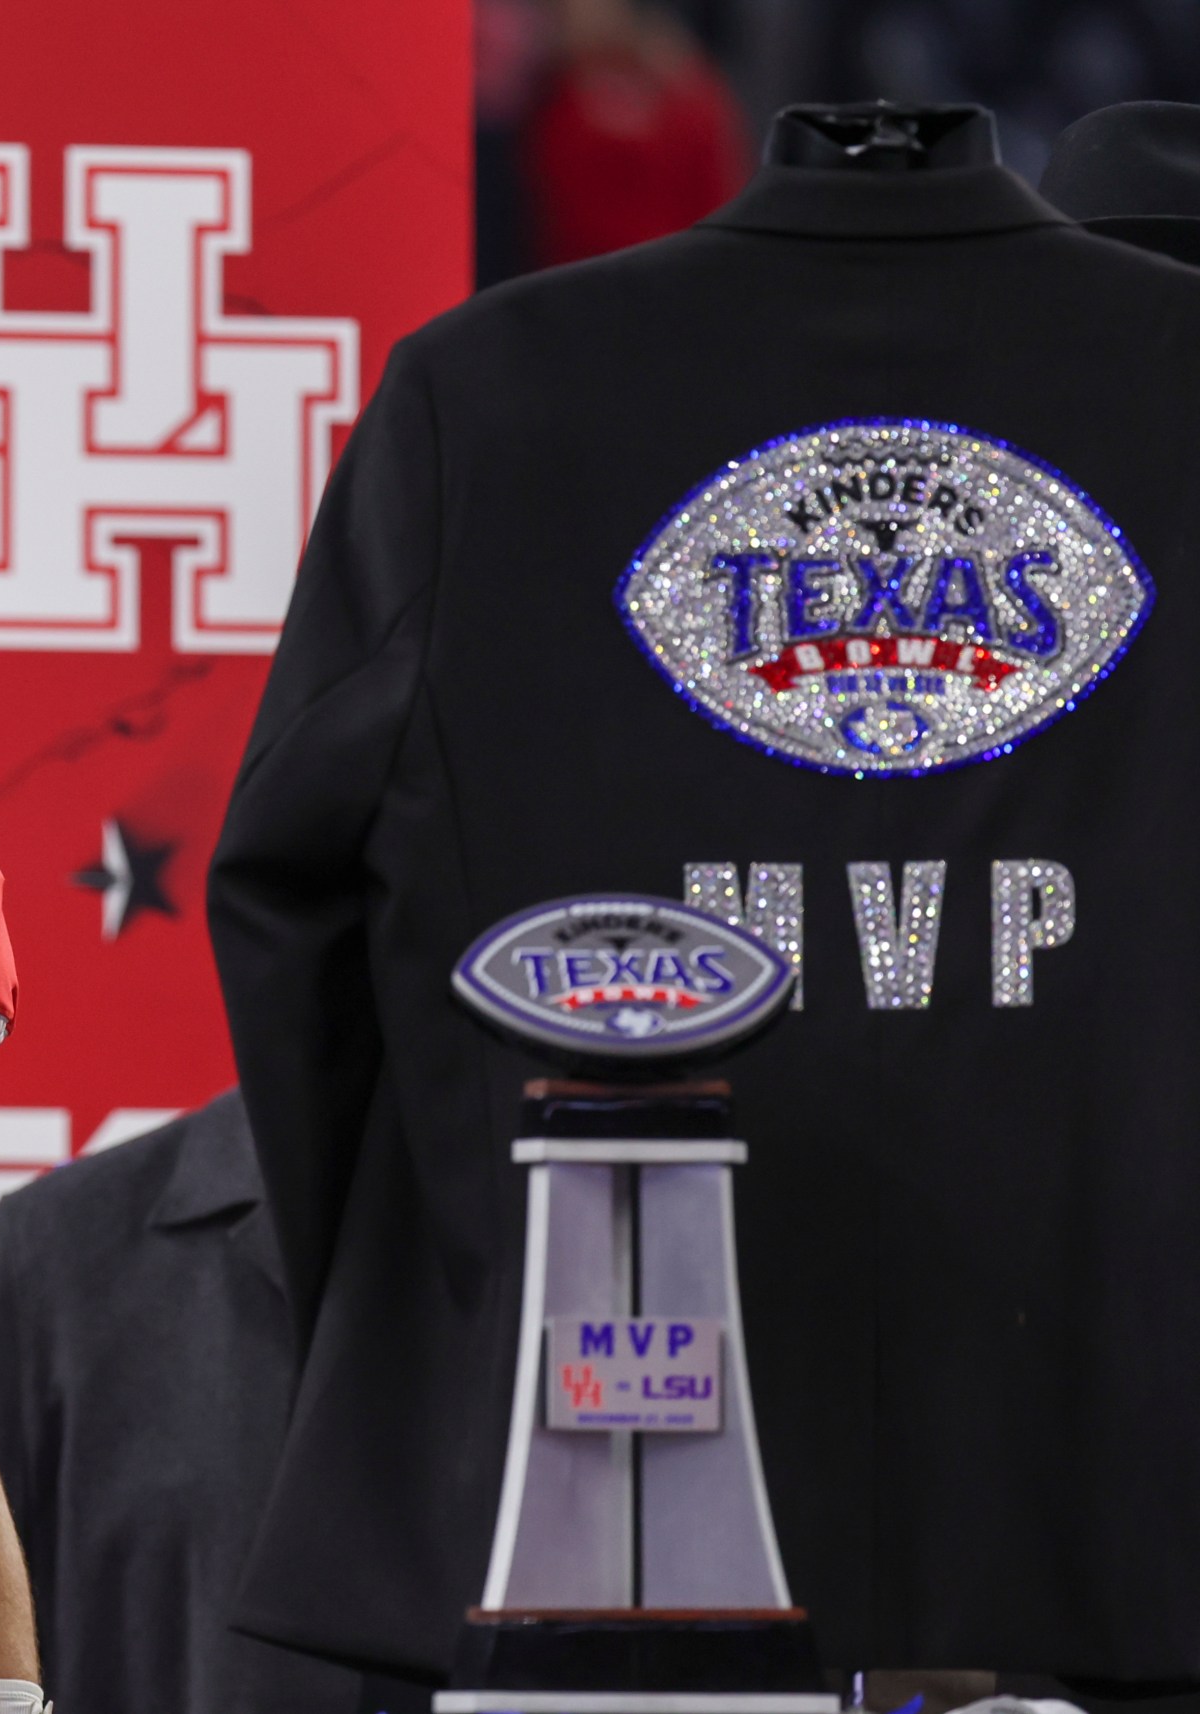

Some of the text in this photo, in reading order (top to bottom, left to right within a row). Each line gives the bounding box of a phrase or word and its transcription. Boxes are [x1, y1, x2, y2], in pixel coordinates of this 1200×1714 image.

[703, 548, 1065, 665] TEXAS
[793, 638, 976, 673] BOWL
[511, 945, 735, 999] TEXAS
[579, 1321, 695, 1358] MVP
[641, 1373, 713, 1400] LSU
